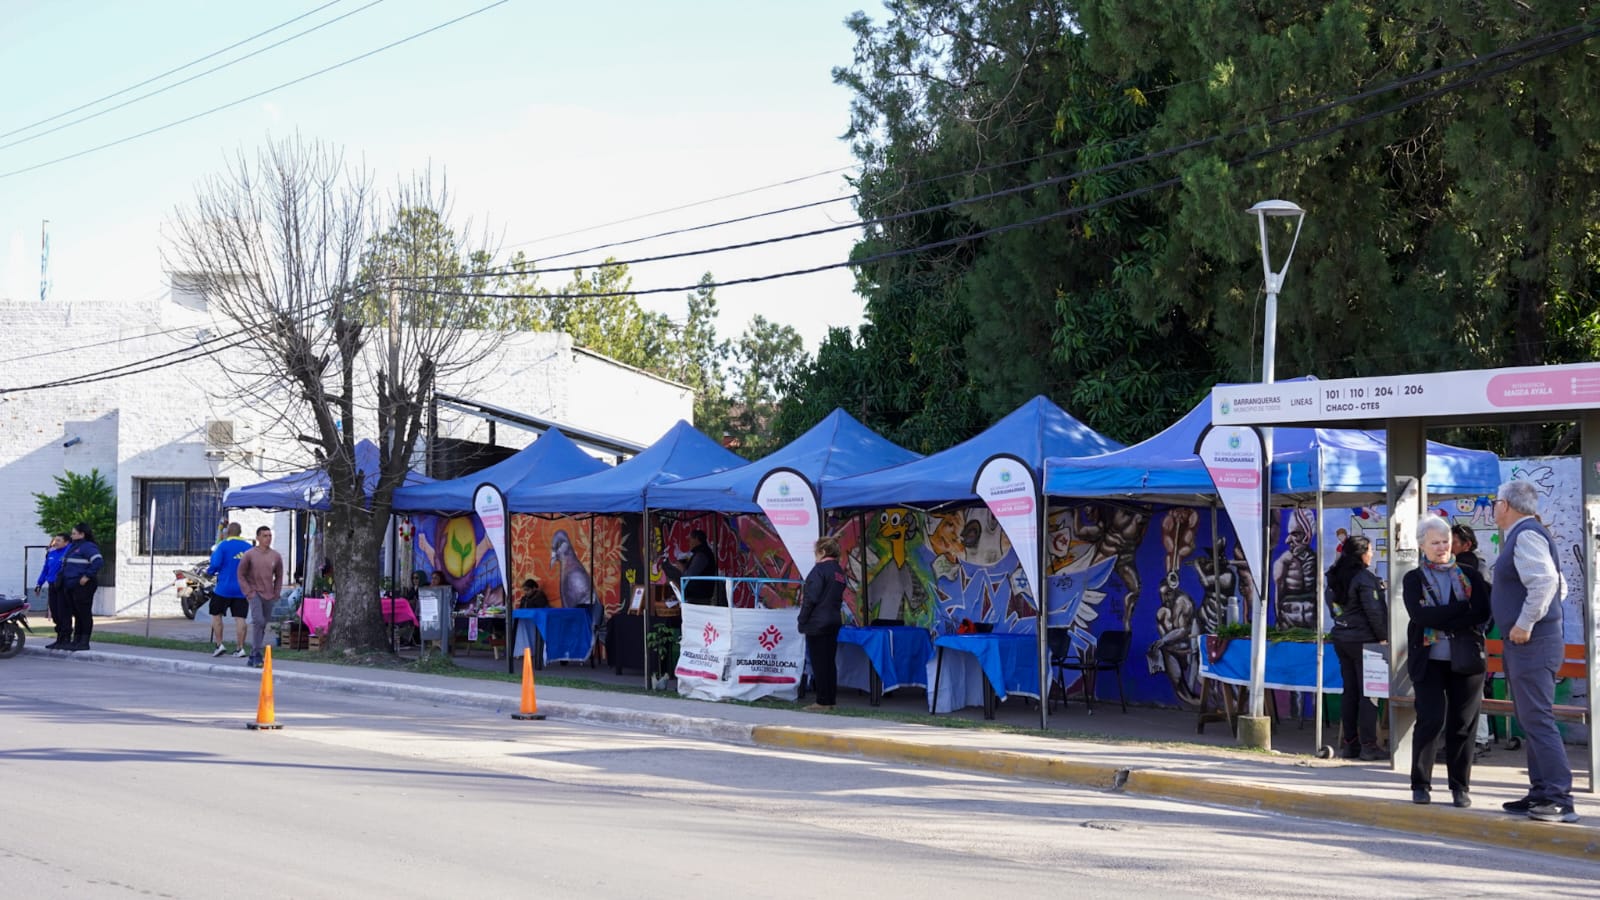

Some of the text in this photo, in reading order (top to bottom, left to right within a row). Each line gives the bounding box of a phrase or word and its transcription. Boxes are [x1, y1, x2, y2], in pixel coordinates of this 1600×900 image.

[1326, 385, 1424, 399] 101 110 204 206
[1530, 387, 1553, 396] AYALA
[1233, 396, 1281, 406] BARRANQUERAS
[1325, 403, 1354, 412] CHACO
[1361, 401, 1380, 410] CTES
[736, 659, 798, 669] DESARROLLO LOCAL
